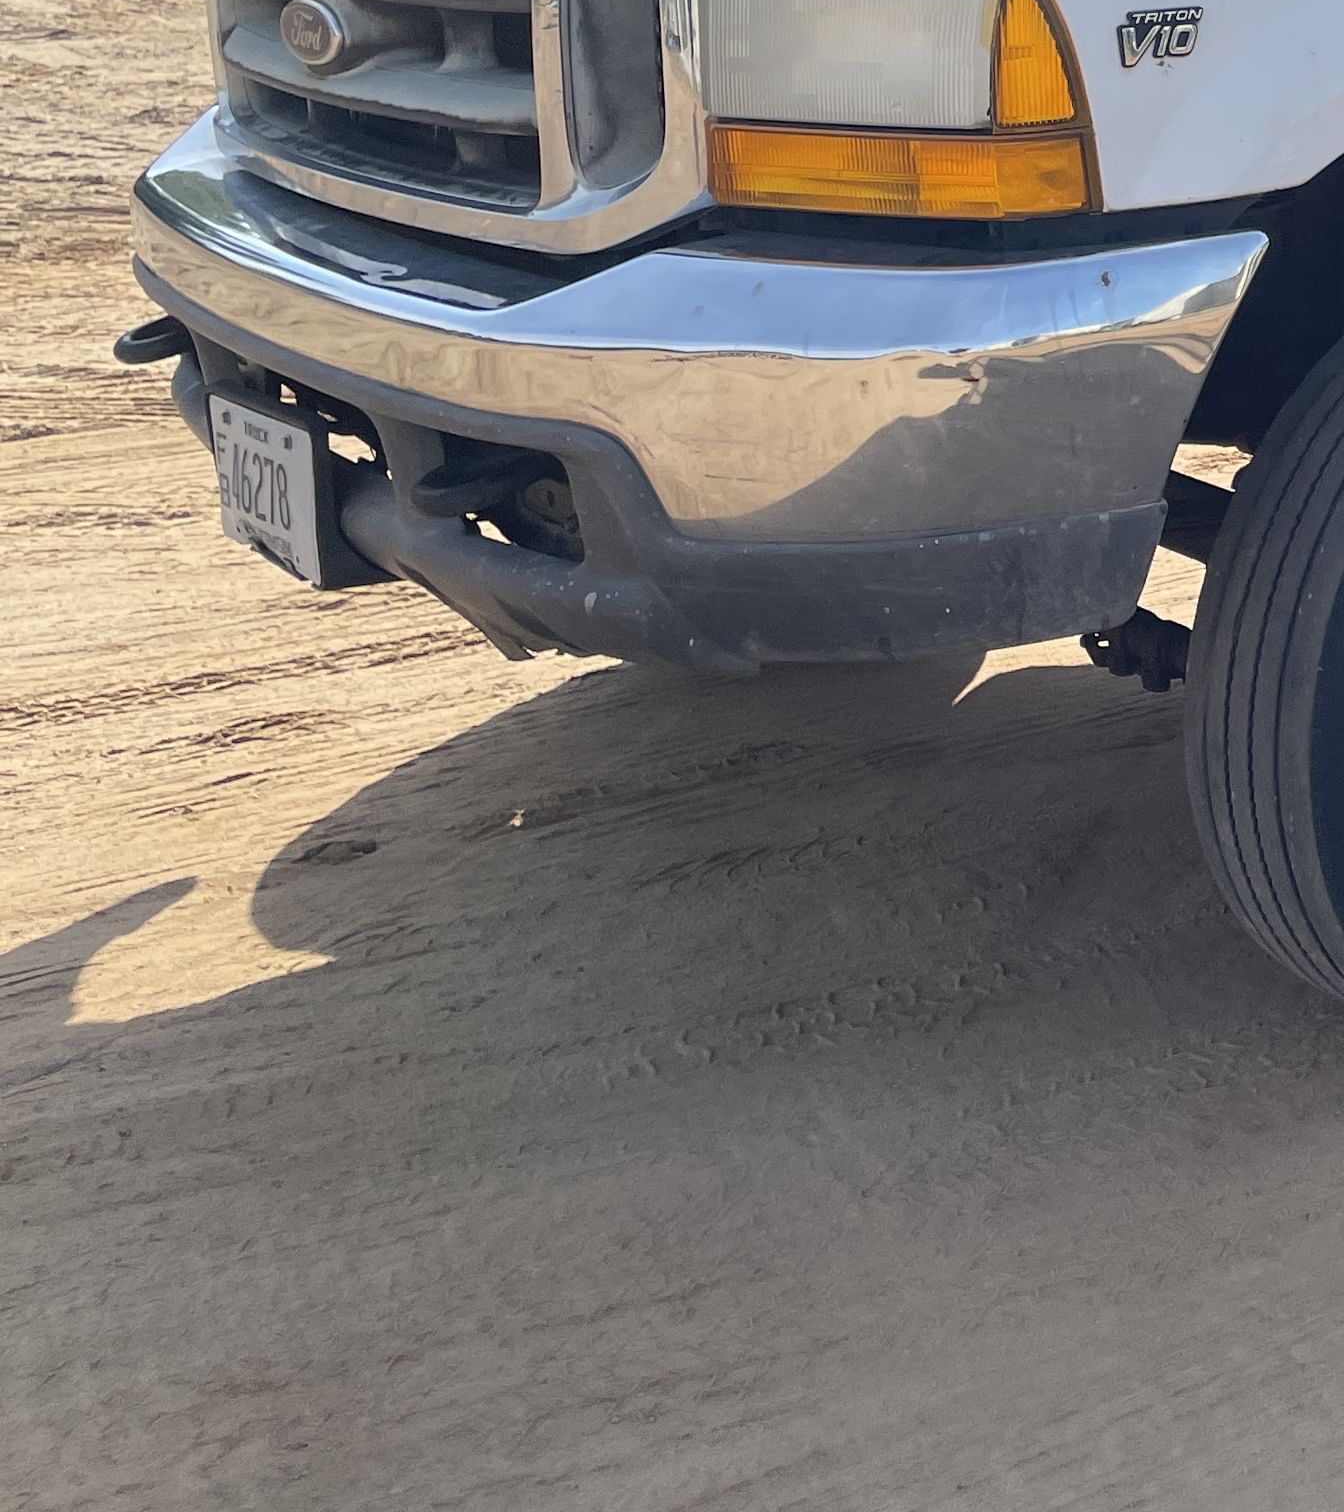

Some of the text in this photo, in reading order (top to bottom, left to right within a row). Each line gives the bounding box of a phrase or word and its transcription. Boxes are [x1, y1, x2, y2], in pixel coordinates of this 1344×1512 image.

[291, 11, 321, 51] Ford
[1131, 8, 1203, 24] TRITON
[1120, 23, 1198, 66] V10
